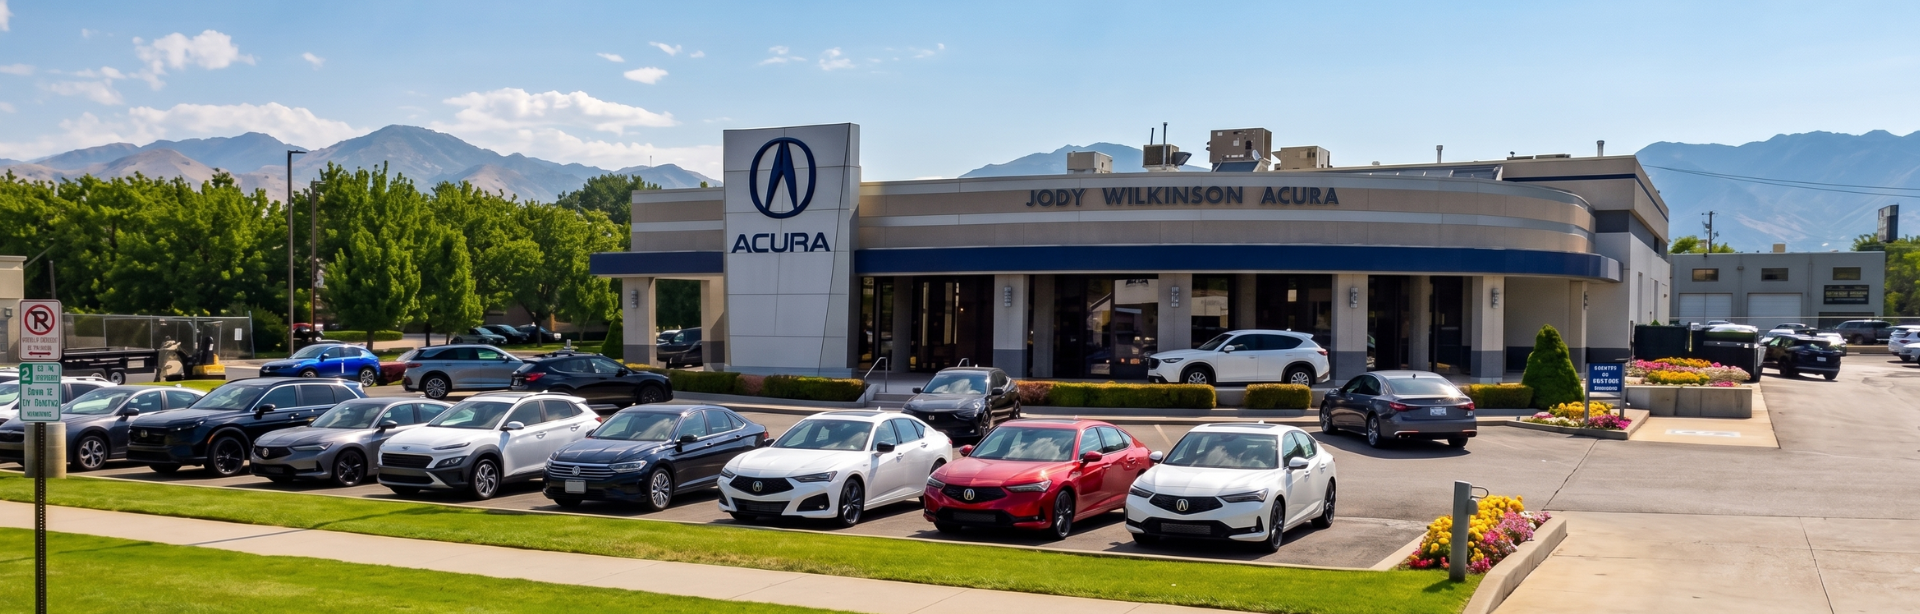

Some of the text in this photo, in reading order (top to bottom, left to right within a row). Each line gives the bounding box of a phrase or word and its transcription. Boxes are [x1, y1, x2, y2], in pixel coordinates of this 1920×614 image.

[1026, 186, 1340, 207] JODY WILKINSON ACURA
[731, 232, 831, 254] ACURA
[22, 367, 30, 381] 2
